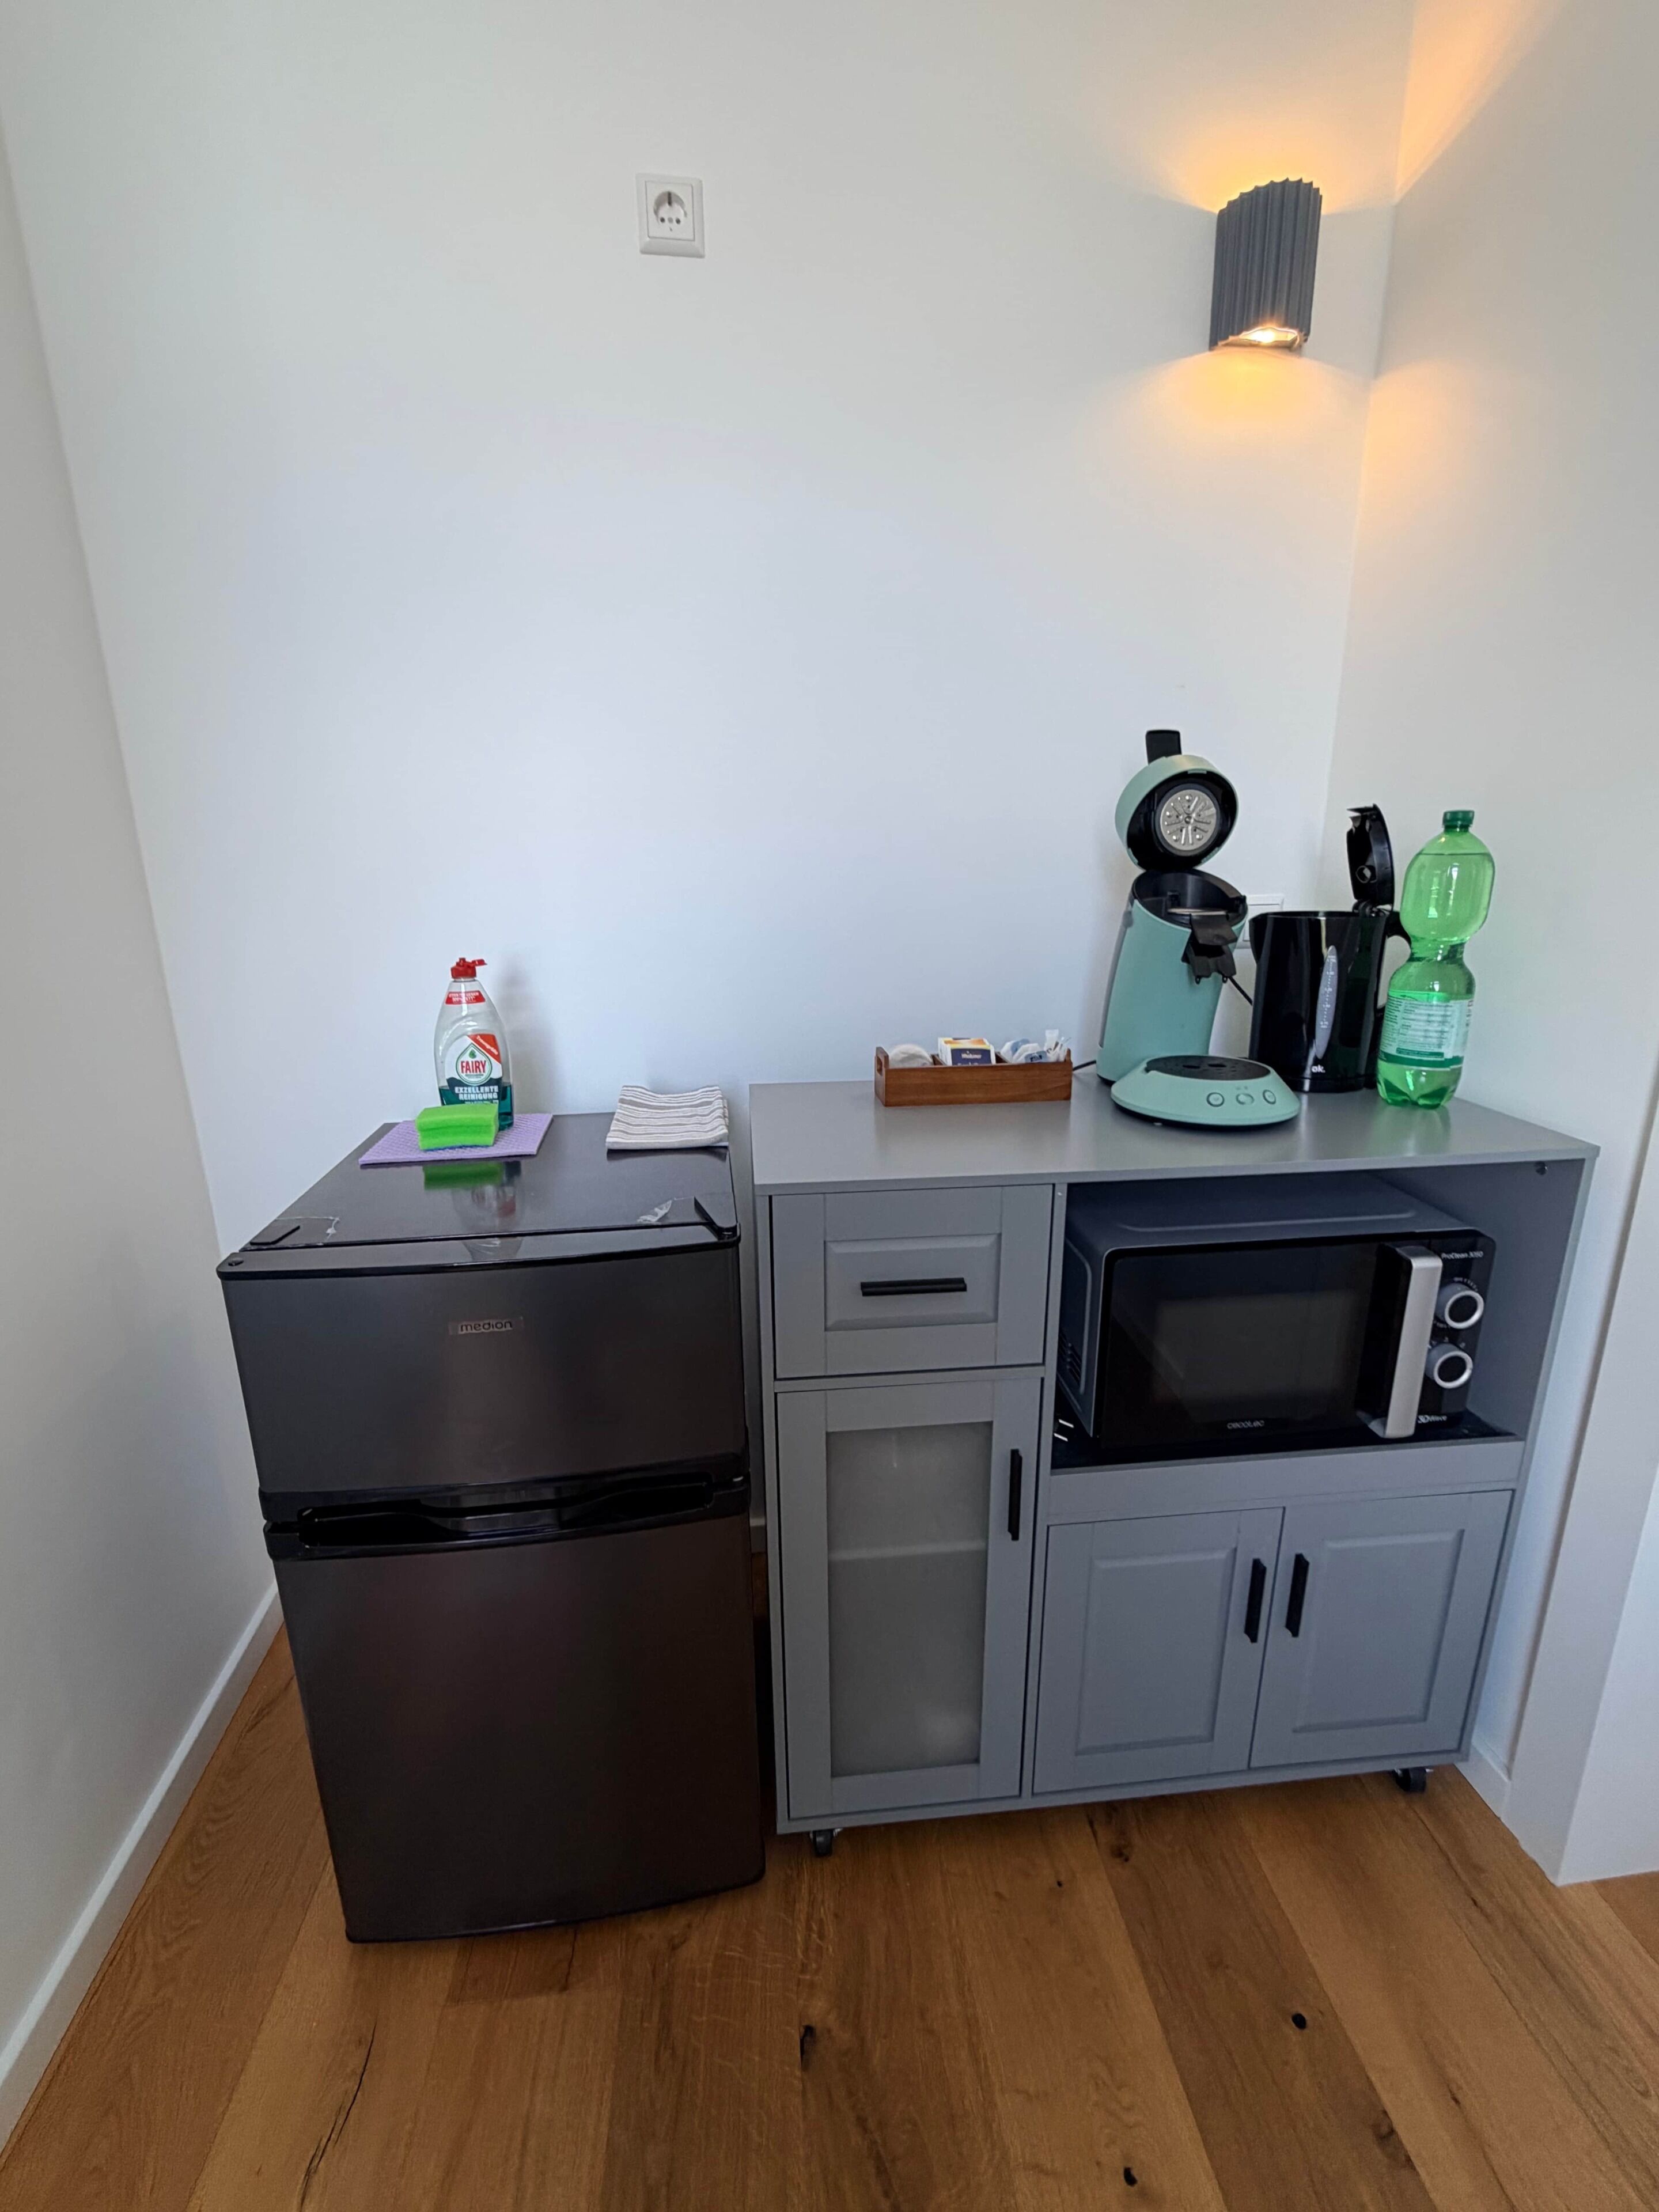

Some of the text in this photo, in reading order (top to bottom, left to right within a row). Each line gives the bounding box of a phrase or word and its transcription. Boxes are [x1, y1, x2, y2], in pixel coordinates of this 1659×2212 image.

[460, 1060, 486, 1074] FAIRY
[459, 1092, 498, 1100] REINIGUNG
[460, 1320, 513, 1332] medion
